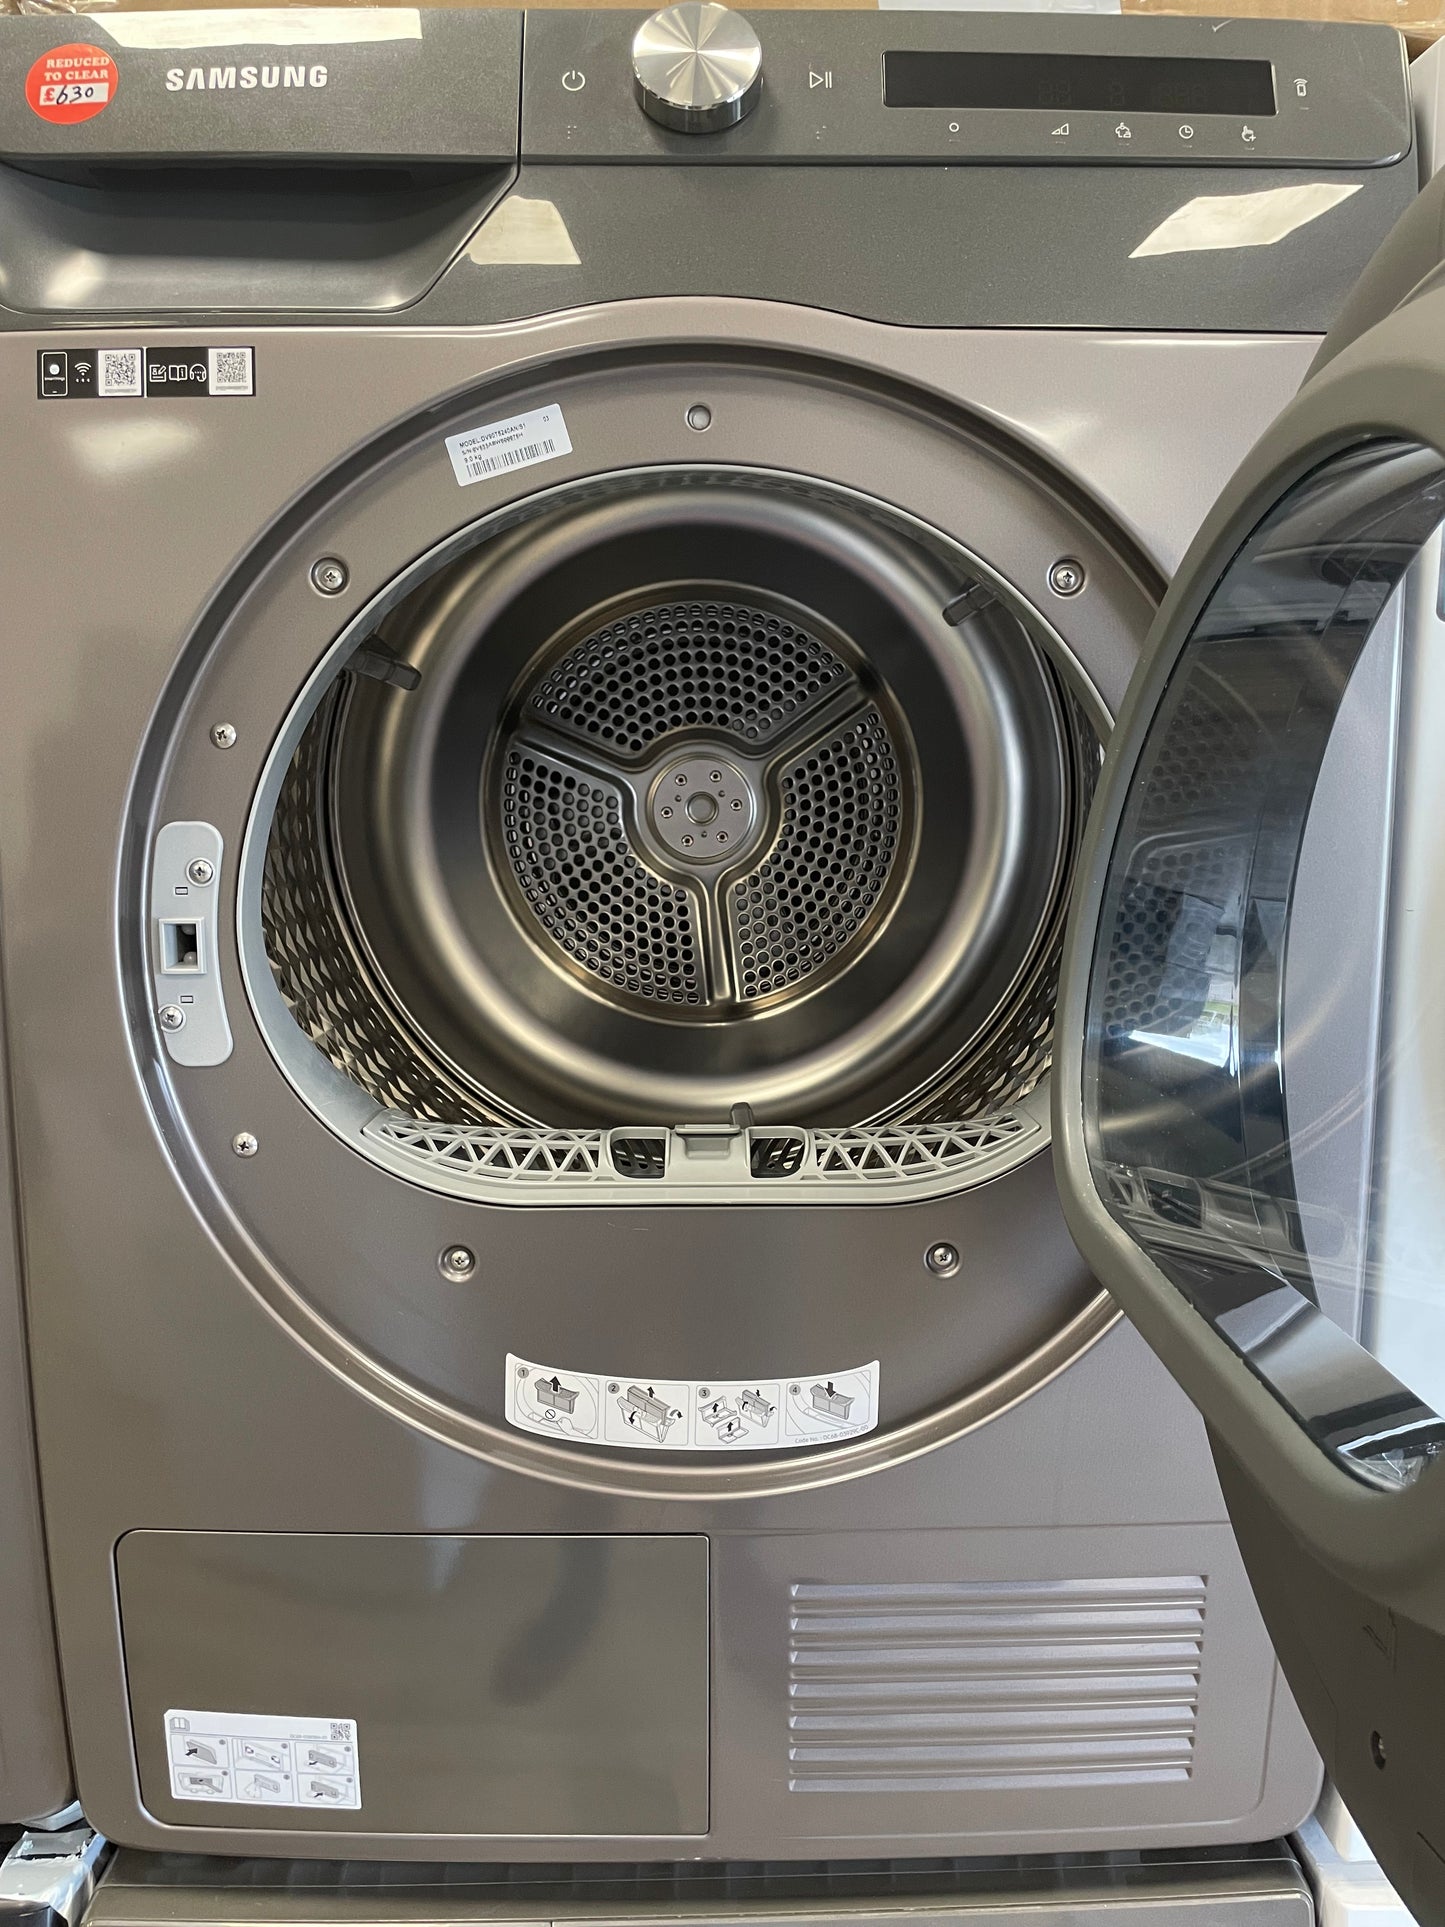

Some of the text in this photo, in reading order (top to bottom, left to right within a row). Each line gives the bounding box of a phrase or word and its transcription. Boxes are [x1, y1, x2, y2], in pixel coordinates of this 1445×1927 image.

[46, 57, 110, 69] REDUCED
[44, 69, 109, 82] TO CLEAR
[165, 65, 328, 92] SAMSUNG
[43, 84, 94, 105] £630
